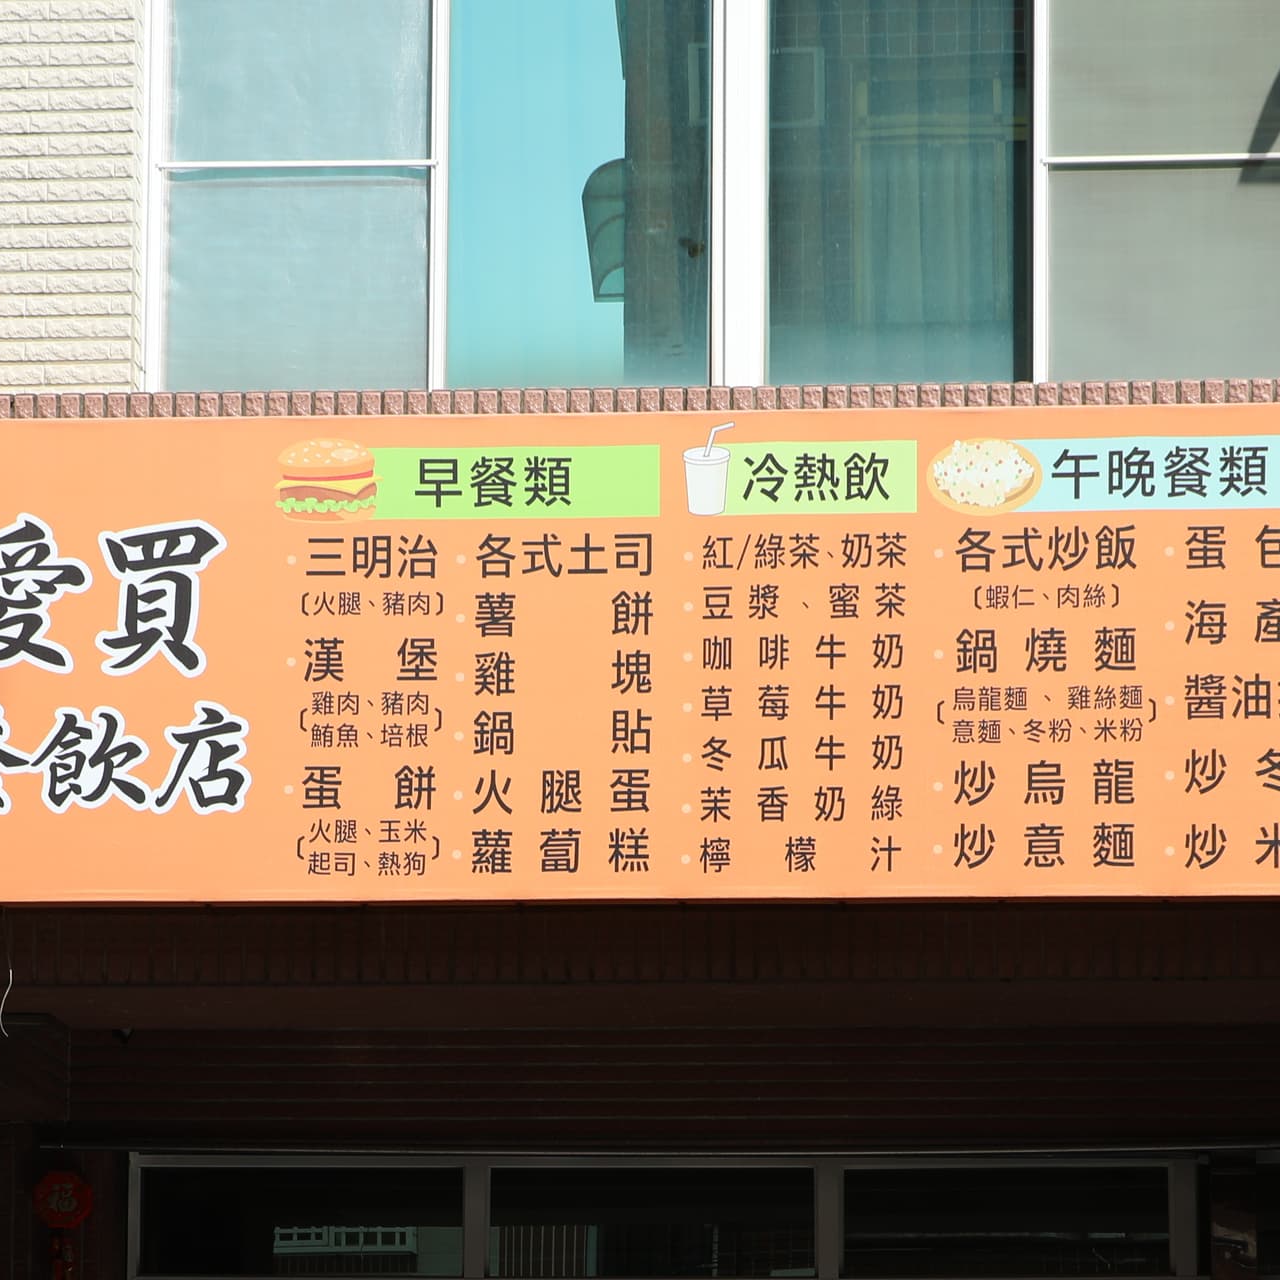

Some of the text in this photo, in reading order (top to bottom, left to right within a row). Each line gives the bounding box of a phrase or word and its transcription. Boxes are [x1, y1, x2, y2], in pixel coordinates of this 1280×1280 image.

[415, 456, 571, 507] 早餐類
[743, 453, 889, 502] 冷熱飲
[1052, 446, 1268, 499] 午晚餐類
[306, 535, 437, 578] 三明治
[476, 533, 651, 578] 各式土司
[956, 525, 1136, 572] 各式炒飯
[475, 591, 653, 637] 薯餅
[305, 638, 437, 682] 漢堡
[475, 650, 651, 696] 雞塊
[703, 634, 903, 670] 咖啡牛奶
[956, 627, 1136, 673] 鍋燒麵
[701, 684, 902, 721] 草莓牛奶
[474, 709, 652, 755] 鍋貼
[702, 735, 902, 771] 冬瓜牛奶
[302, 765, 436, 810] 蛋餅
[473, 769, 650, 814] 火腿蛋
[701, 785, 902, 822] 茉香奶綠
[955, 759, 1134, 806] 炒烏龍
[472, 828, 649, 874] 蘿蔔糕
[700, 836, 901, 873] 檸檬汁
[954, 822, 1134, 869] 炒意麵
